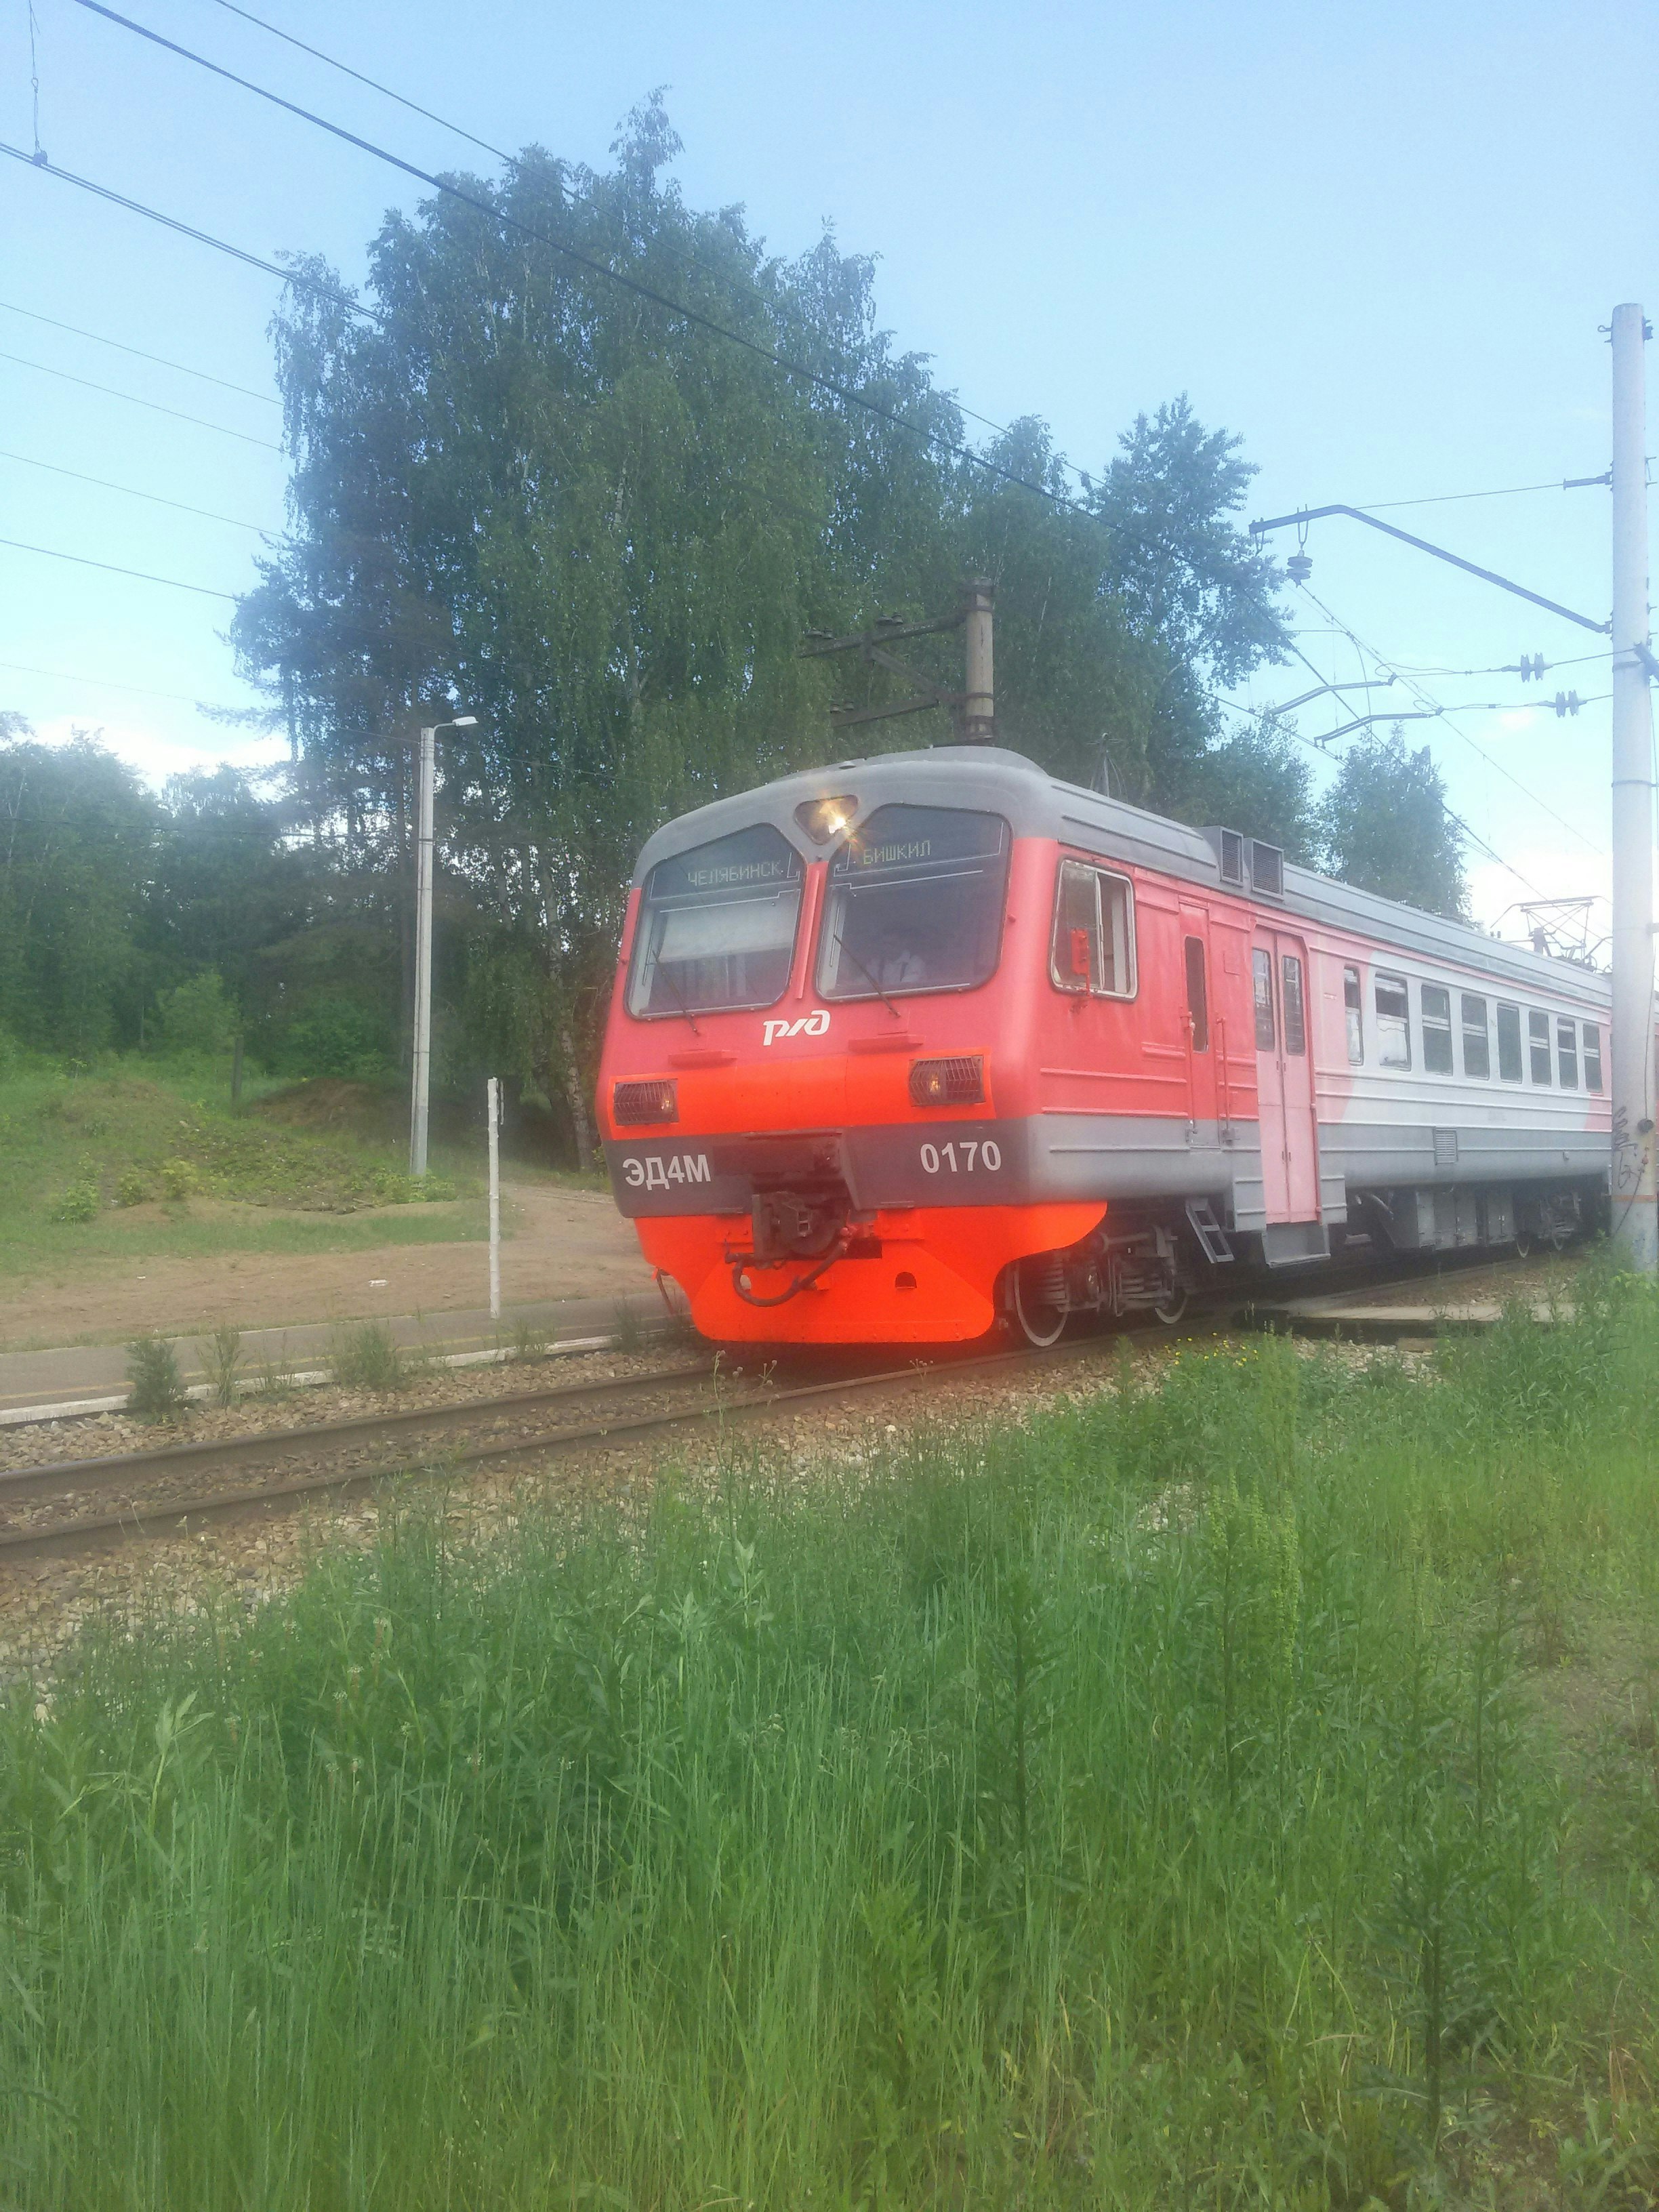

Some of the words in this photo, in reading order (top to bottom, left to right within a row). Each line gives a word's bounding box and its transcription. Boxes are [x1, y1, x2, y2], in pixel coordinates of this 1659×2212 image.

[863, 840, 930, 865] БИШКИЛ
[688, 860, 781, 886] ЧЕЛЯБИНСК
[763, 1010, 830, 1046] РЖД
[622, 1154, 711, 1191] ЭД4М
[920, 1141, 1002, 1173] 0170
